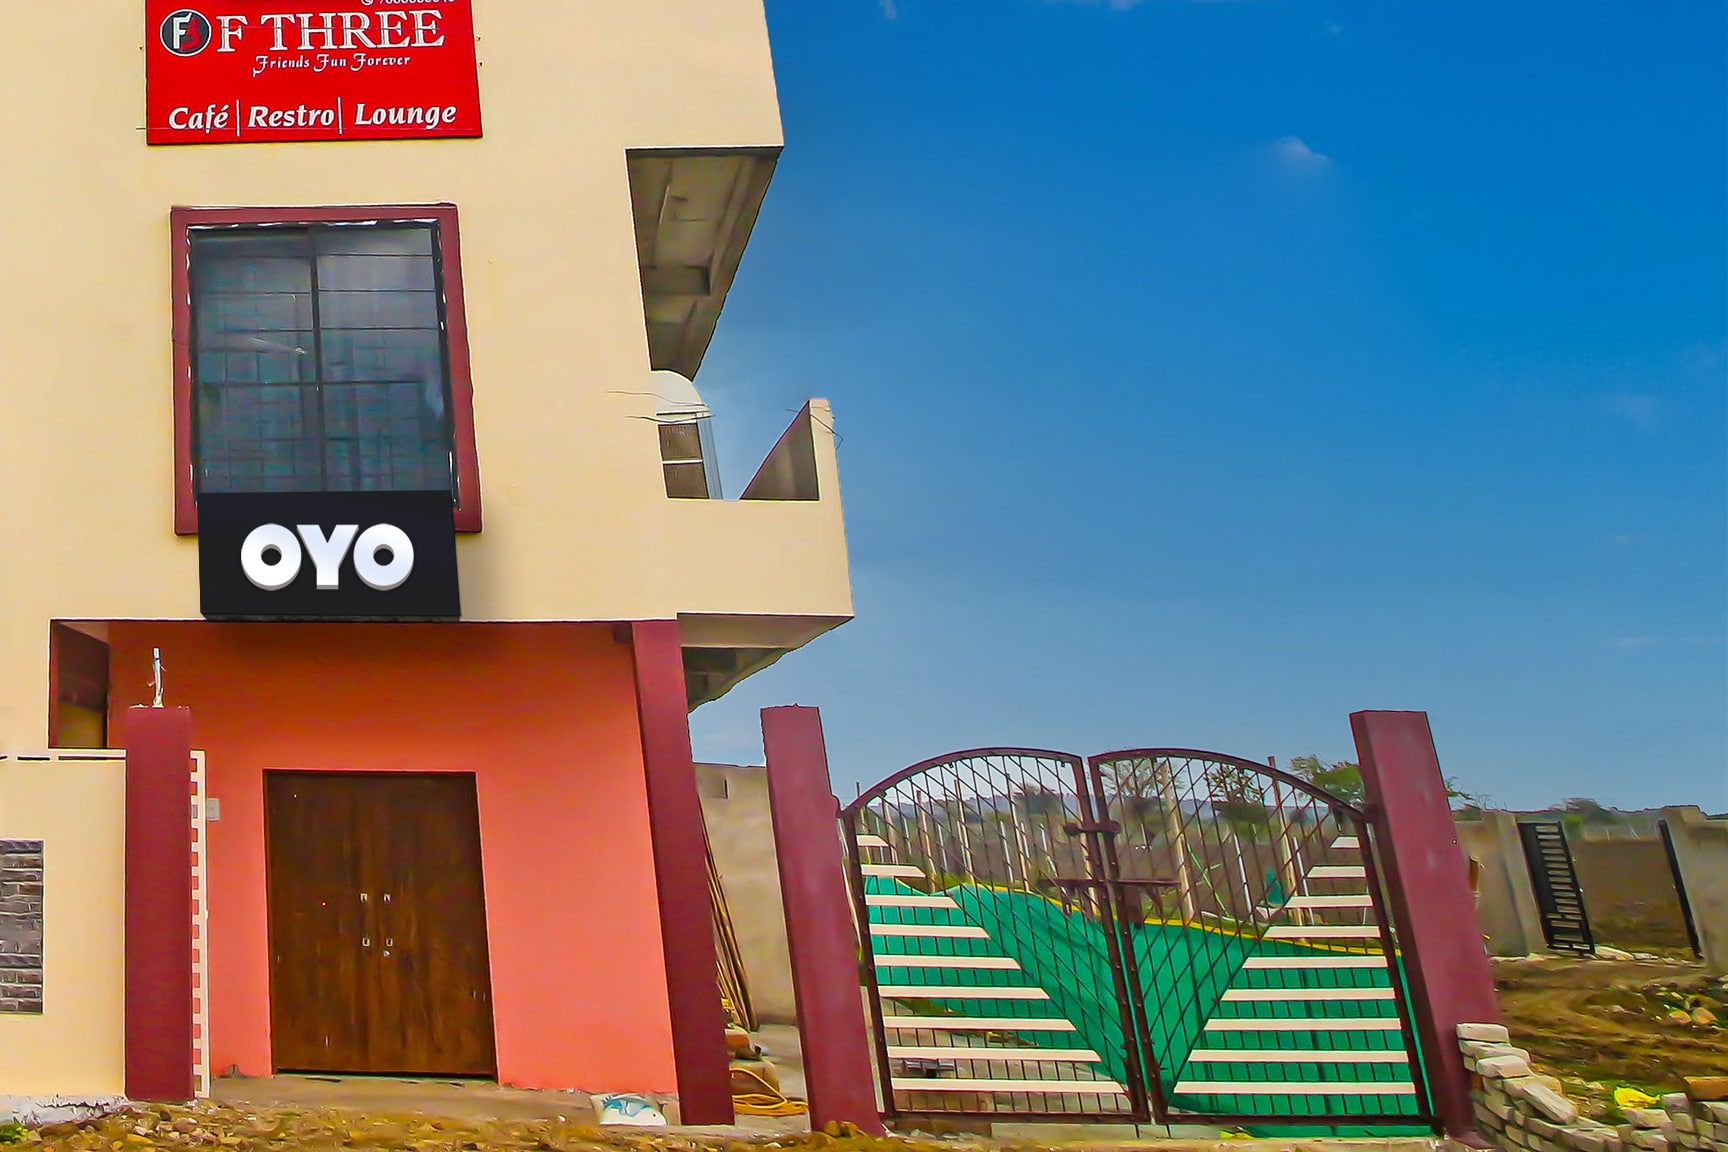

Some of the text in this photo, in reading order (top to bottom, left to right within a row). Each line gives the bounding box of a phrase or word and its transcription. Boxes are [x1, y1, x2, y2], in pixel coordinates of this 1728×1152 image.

[216, 9, 445, 53] F THREE
[252, 52, 411, 78] Friends Fun Forever
[168, 102, 457, 134] Café Restro Lounge
[240, 523, 415, 591] OYO
